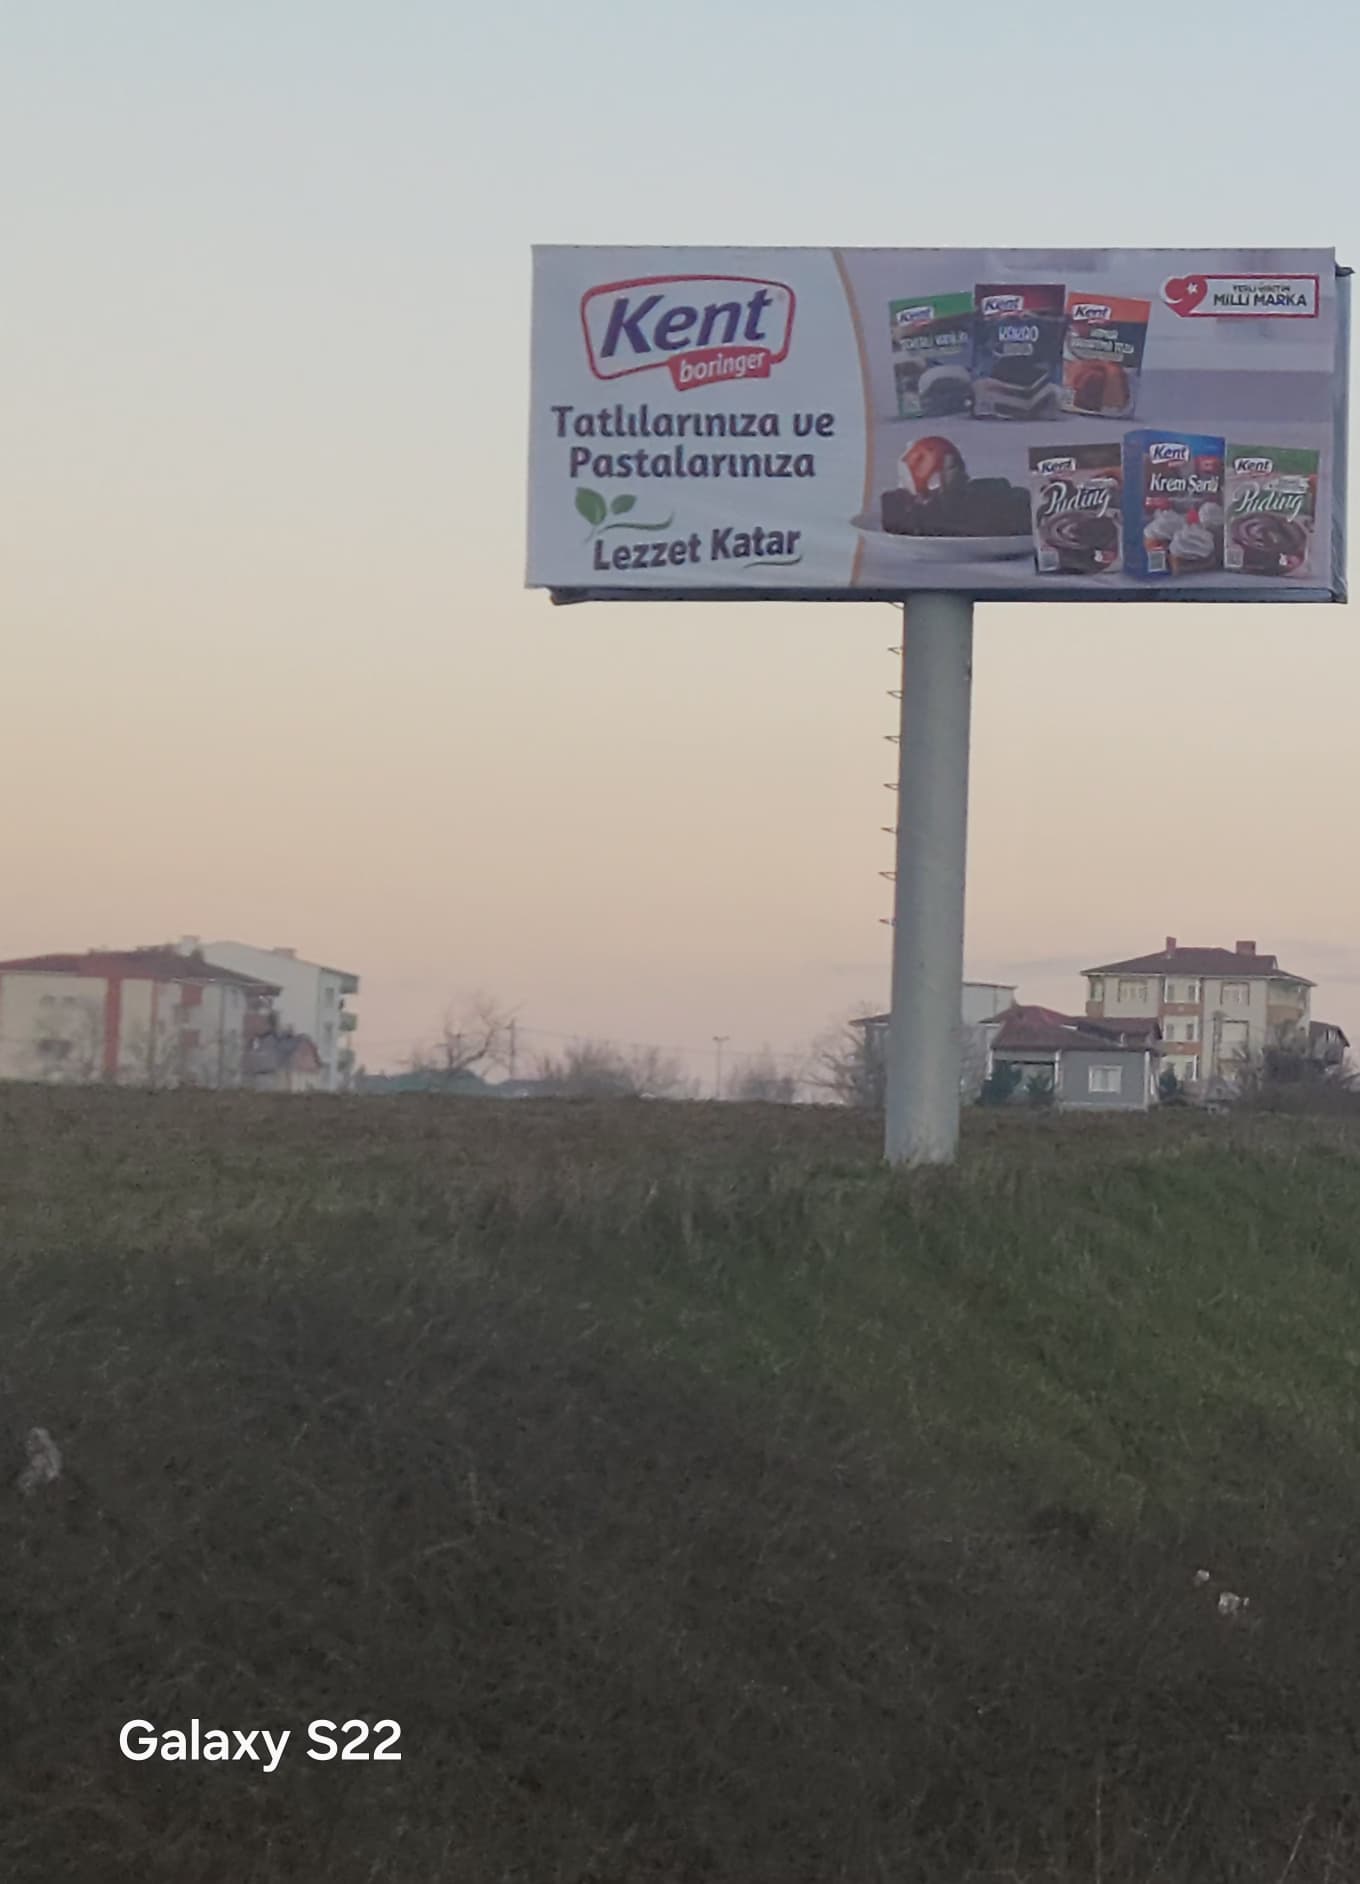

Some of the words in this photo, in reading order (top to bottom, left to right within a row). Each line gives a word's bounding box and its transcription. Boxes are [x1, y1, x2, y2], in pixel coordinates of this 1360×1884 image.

[1075, 306, 1109, 317] Kent
[1253, 293, 1307, 306] MARKA
[600, 289, 773, 358] Kent
[680, 350, 766, 384] boringer
[551, 404, 779, 438] Tatlılarınıza
[792, 411, 835, 437] ve
[569, 445, 815, 479] Pastalarınıza
[1153, 445, 1186, 459] Kent
[1237, 460, 1270, 471] Kent
[1150, 472, 1186, 492] Krem
[593, 533, 701, 570] Lezzet
[711, 526, 801, 561] Katar
